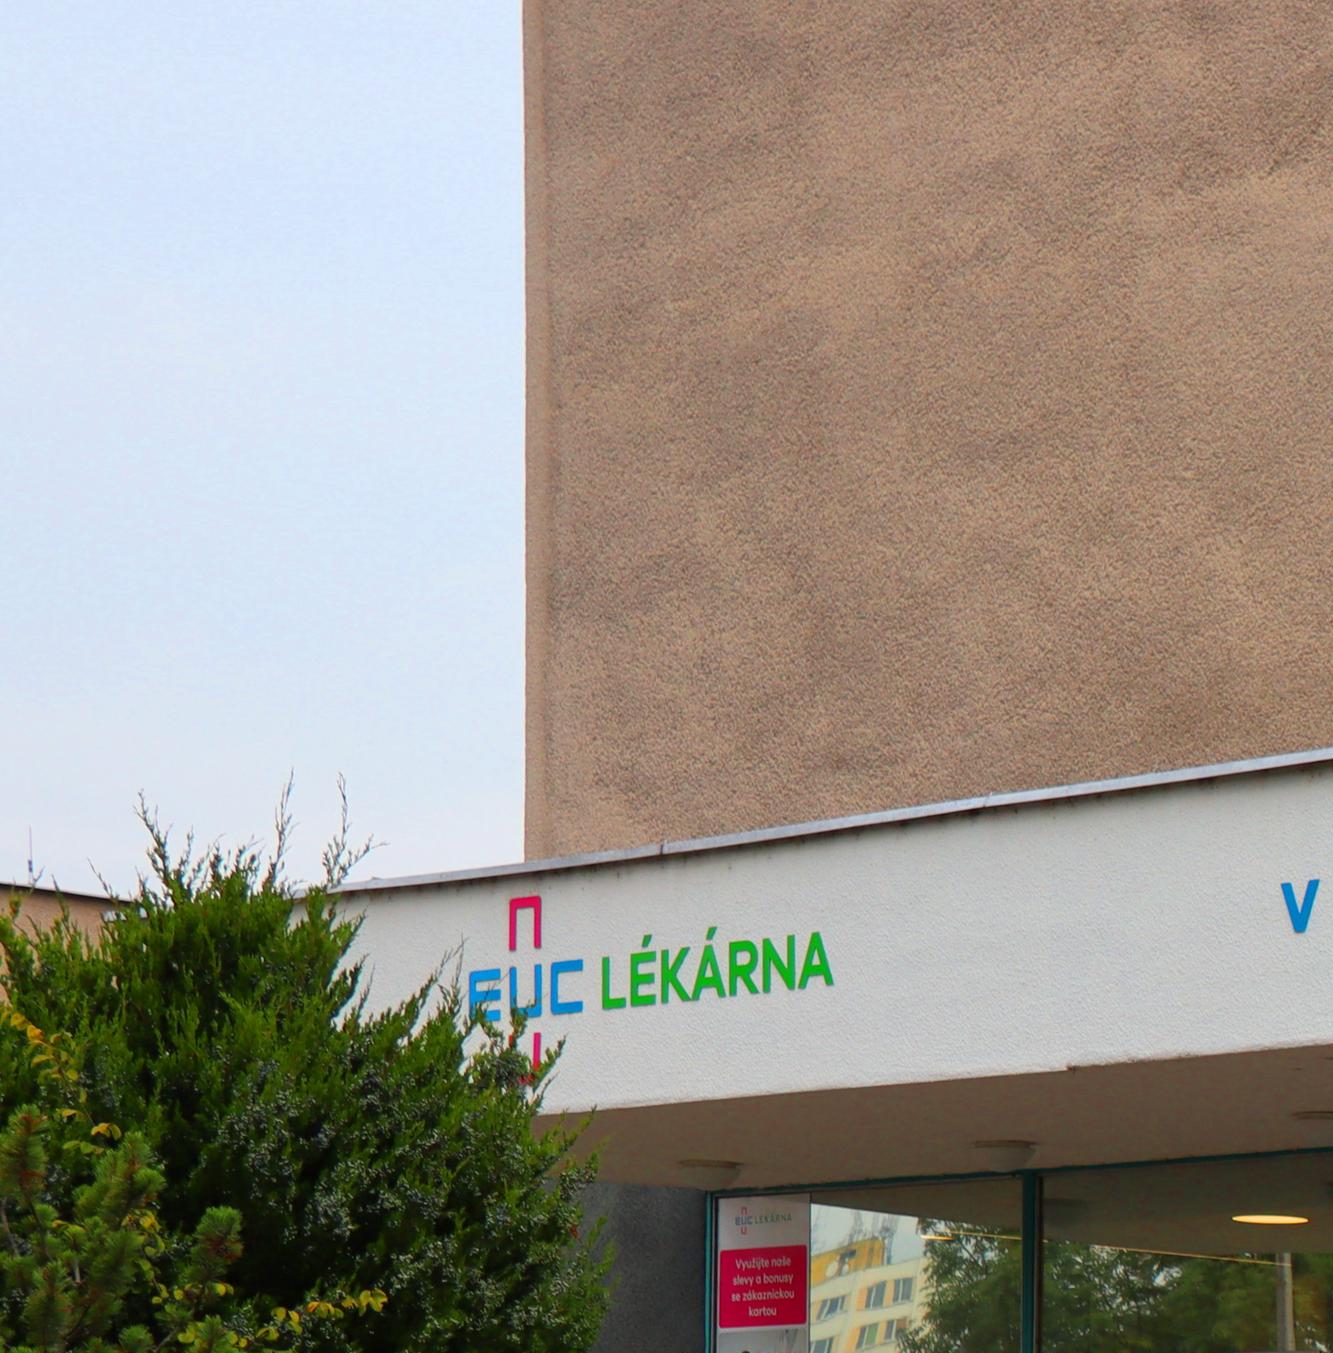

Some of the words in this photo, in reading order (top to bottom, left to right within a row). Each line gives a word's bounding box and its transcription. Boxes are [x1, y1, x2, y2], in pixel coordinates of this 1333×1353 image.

[1281, 879, 1319, 933] v
[469, 959, 583, 1022] EUC
[601, 926, 834, 1010] LÉKÁRNA
[735, 1258, 770, 1271] Využijte
[771, 1256, 791, 1267] naše
[733, 1275, 754, 1287] slevy
[755, 1277, 761, 1285] a
[763, 1273, 794, 1285] bonusy
[731, 1293, 741, 1302] se
[748, 1306, 777, 1317] kartou
